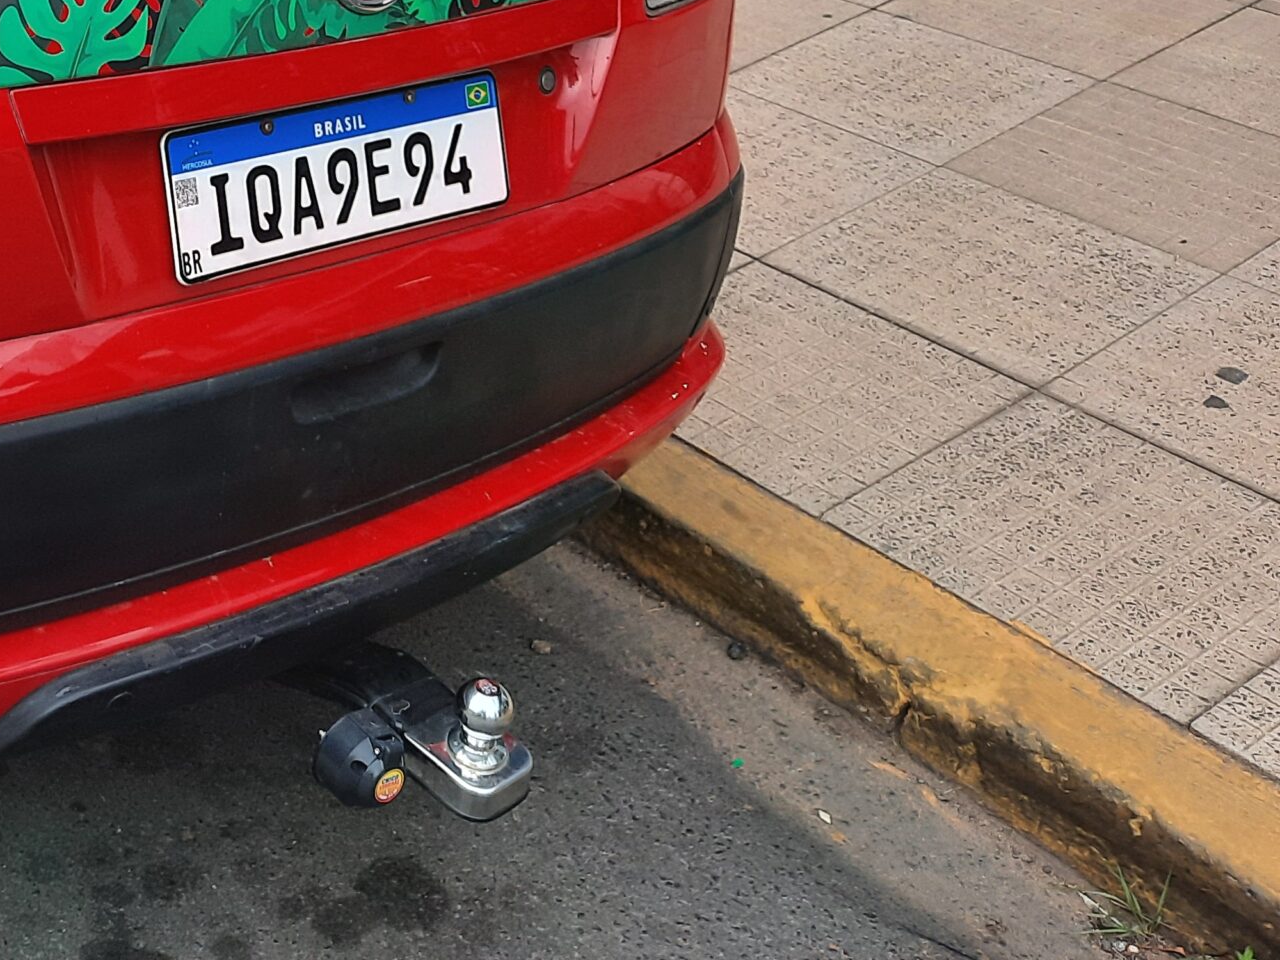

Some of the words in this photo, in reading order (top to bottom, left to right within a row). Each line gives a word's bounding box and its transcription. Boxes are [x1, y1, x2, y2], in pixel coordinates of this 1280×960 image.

[314, 114, 366, 138] BRASIL
[182, 158, 214, 171] MERCOSUL
[210, 123, 472, 257] IQA9E94
[182, 250, 203, 277] BR
